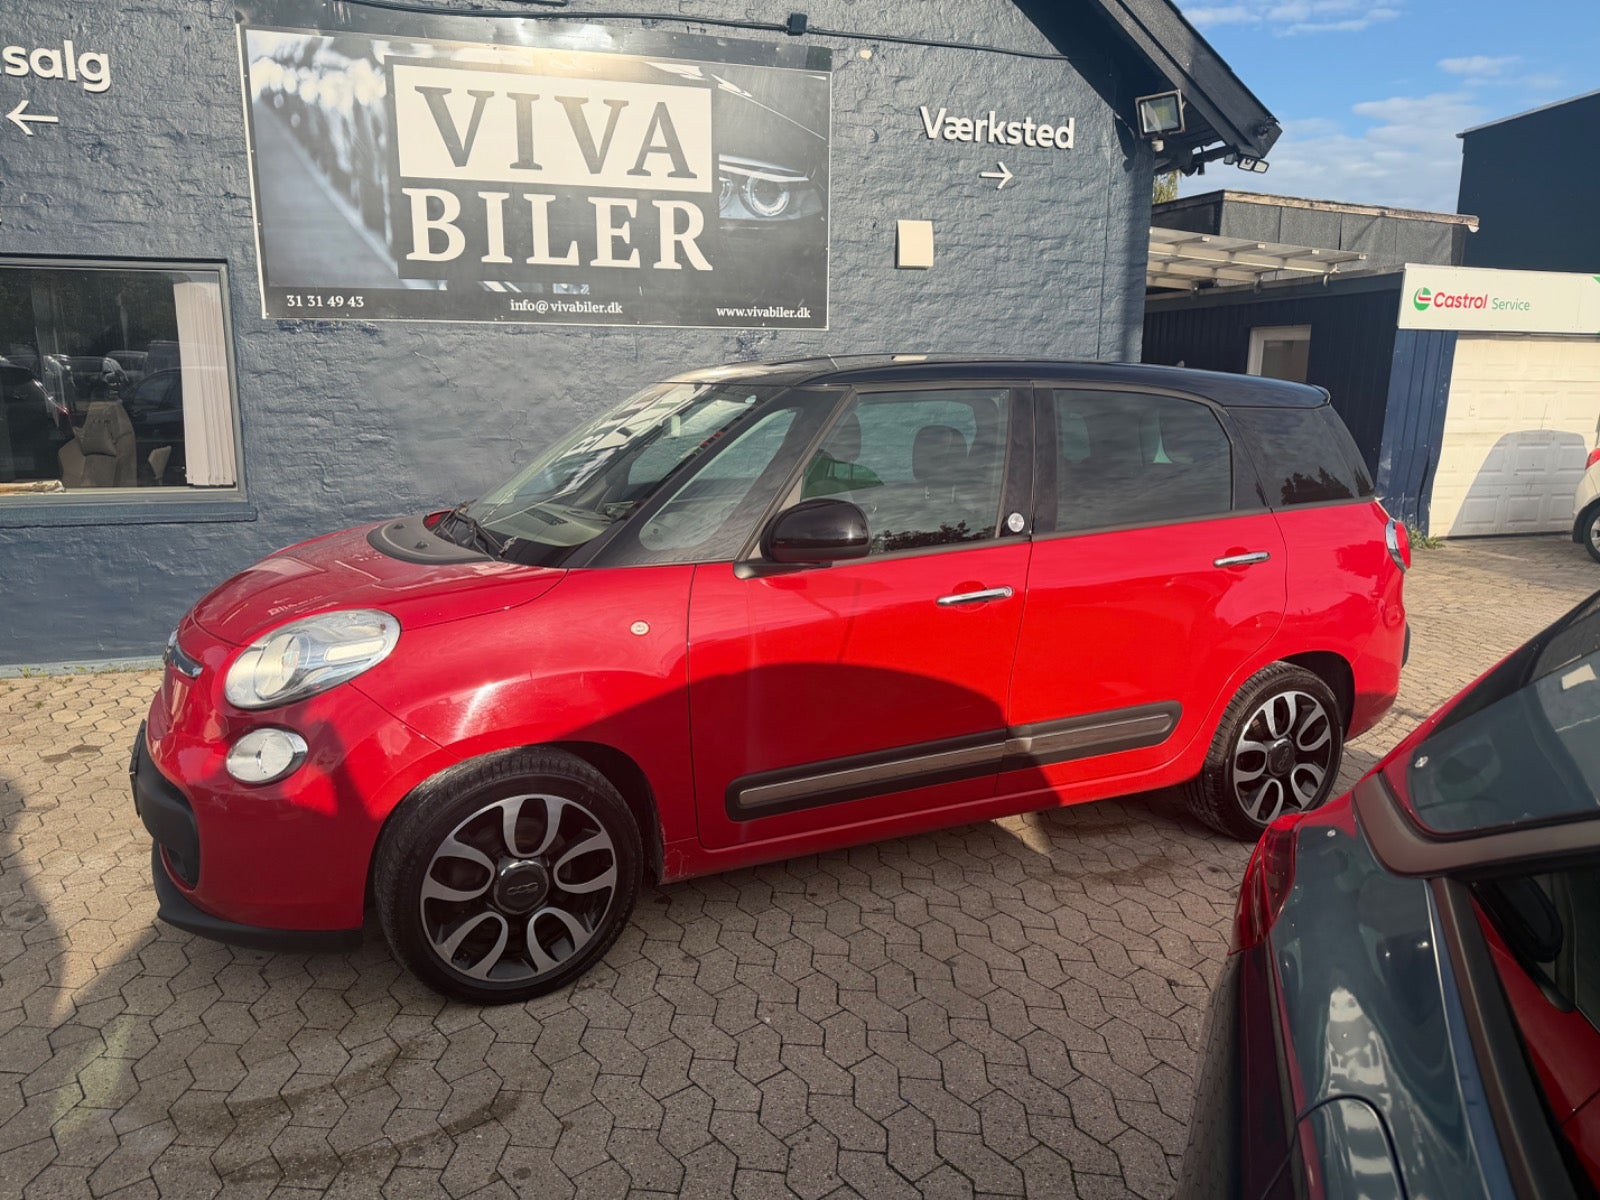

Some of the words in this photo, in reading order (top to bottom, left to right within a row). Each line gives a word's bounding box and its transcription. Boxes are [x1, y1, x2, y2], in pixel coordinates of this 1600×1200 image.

[0, 40, 111, 93] salg
[414, 85, 698, 180] VIVA
[920, 106, 1076, 149] Værksted
[402, 187, 714, 272] BILER
[286, 295, 303, 307] 31
[307, 295, 323, 307] 31
[327, 295, 344, 307] 49
[347, 296, 364, 308] 43
[510, 299, 623, 314] info@vivabiler.dk
[716, 306, 811, 318] www.vivabiler.dk
[1433, 291, 1489, 309] Castrol
[1491, 297, 1531, 311] Service
